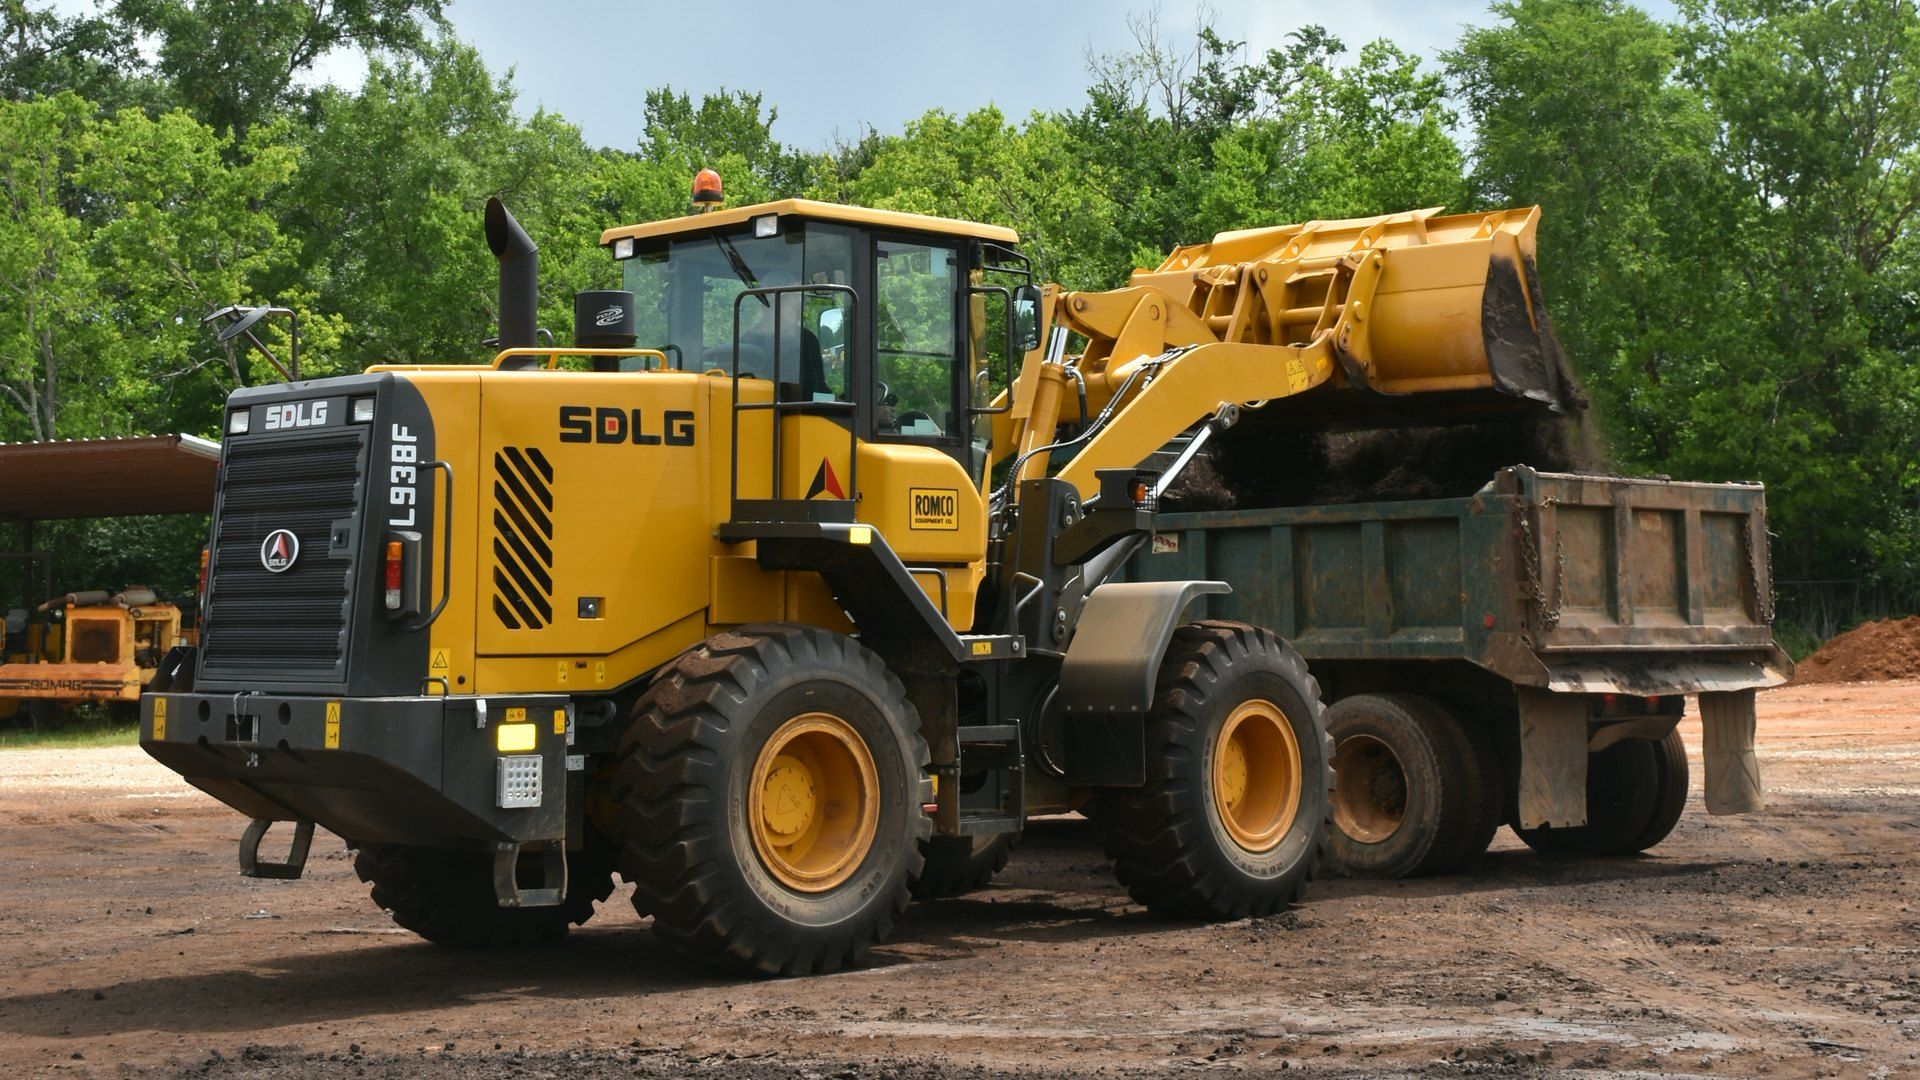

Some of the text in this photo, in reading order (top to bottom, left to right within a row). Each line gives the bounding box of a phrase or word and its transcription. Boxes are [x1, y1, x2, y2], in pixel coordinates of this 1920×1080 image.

[265, 401, 328, 430] SDLG
[560, 406, 695, 447] SDLG
[389, 423, 418, 526] L938F
[915, 495, 953, 516] ROMCO
[268, 559, 287, 567] SDLG
